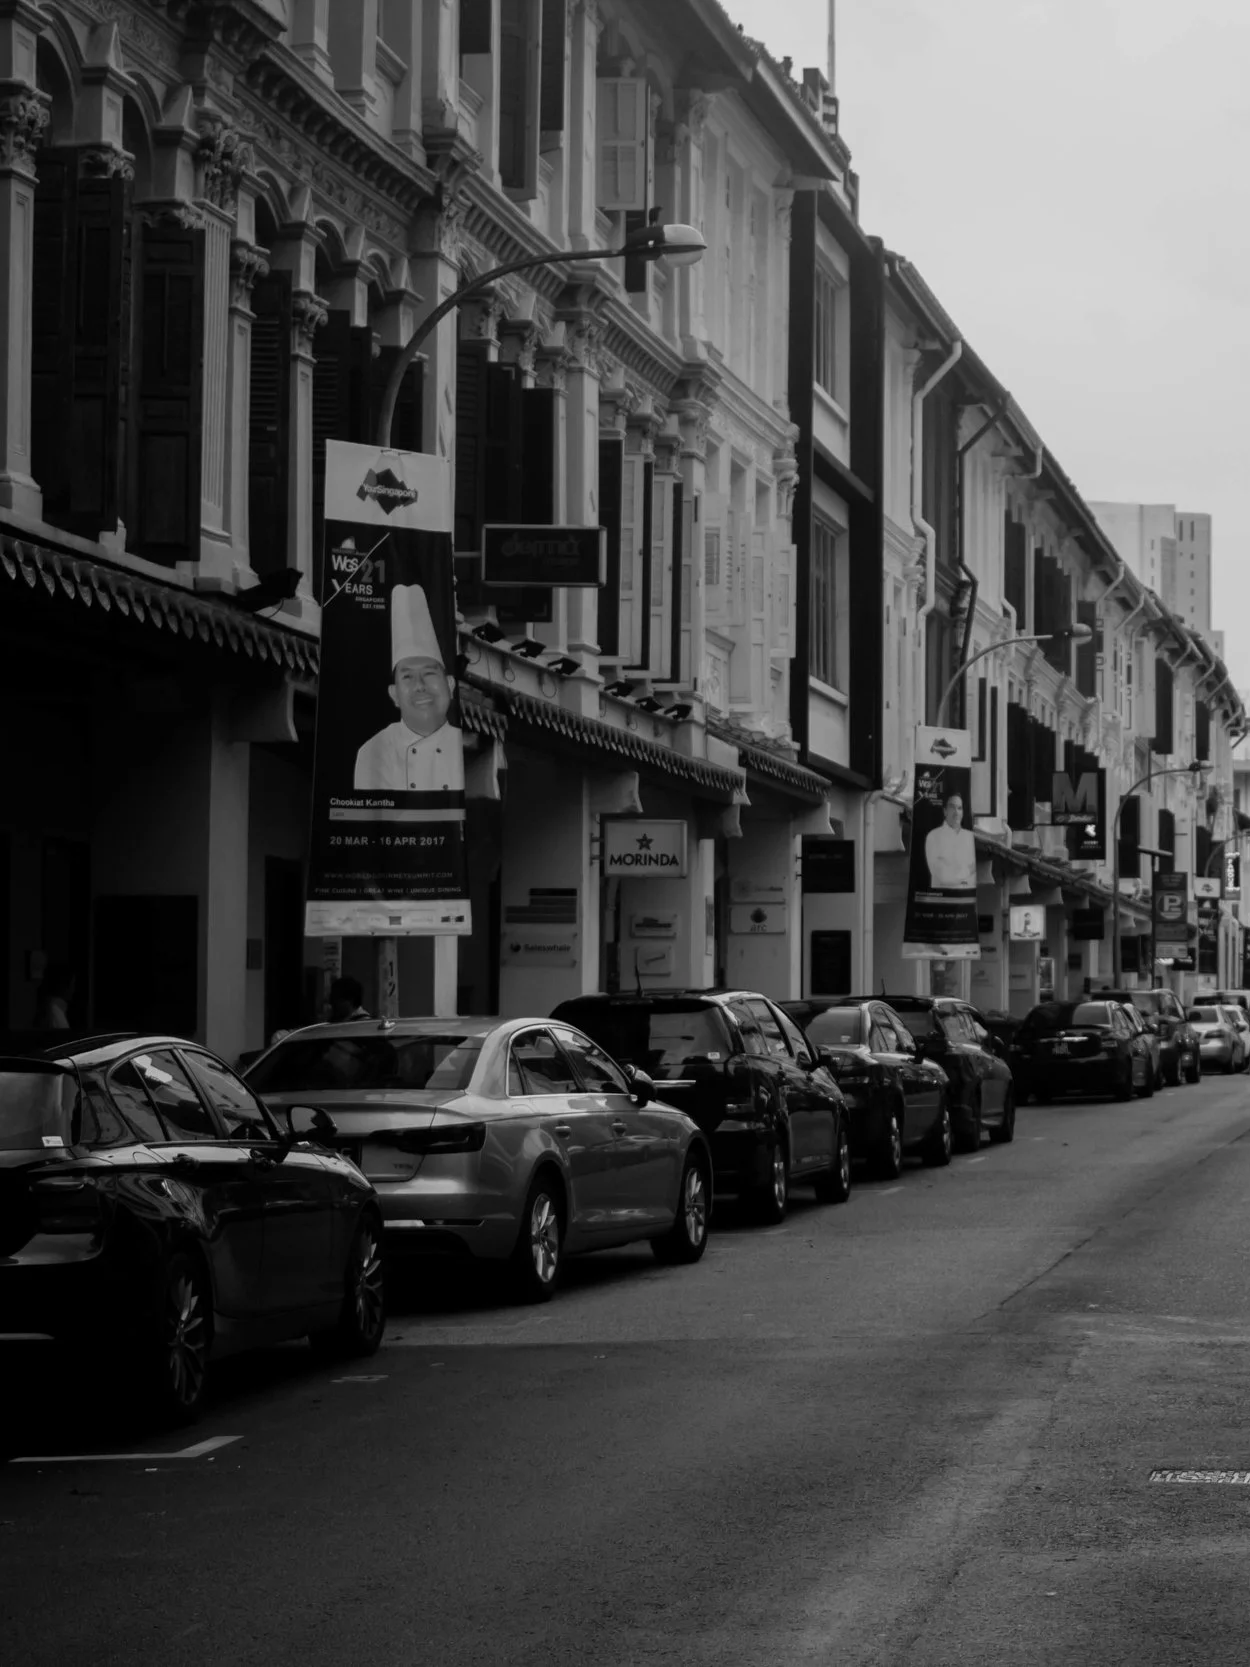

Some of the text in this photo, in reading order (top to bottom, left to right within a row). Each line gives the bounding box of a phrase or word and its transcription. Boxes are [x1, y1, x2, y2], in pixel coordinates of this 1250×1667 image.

[361, 558, 386, 584] 21
[331, 578, 373, 595] YEARS
[329, 797, 395, 807] Chookiat Kantha
[329, 835, 342, 845] 20
[344, 836, 369, 846] MAR
[394, 836, 417, 846] APR
[420, 836, 446, 846] 2017
[609, 853, 679, 866] MORINDA
